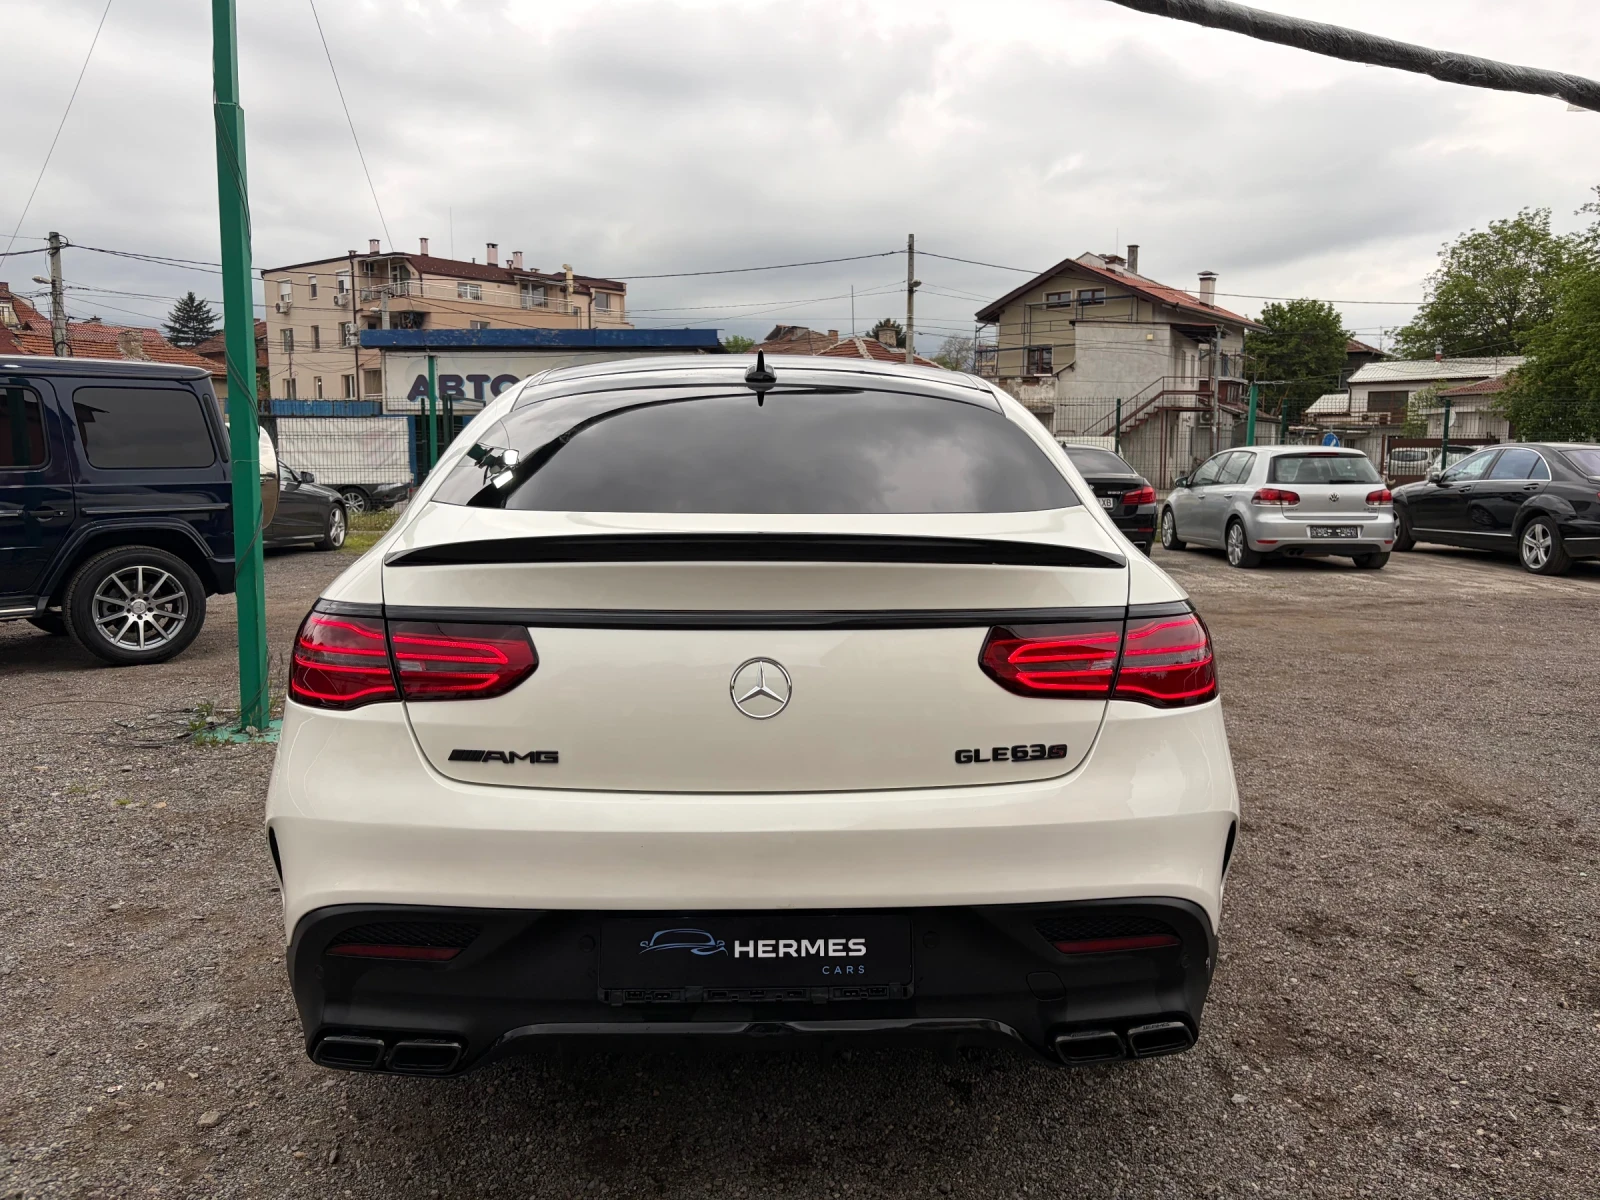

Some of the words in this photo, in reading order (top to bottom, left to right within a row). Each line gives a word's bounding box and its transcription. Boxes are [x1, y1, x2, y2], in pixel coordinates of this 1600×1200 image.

[407, 374, 534, 403] АВТО
[482, 750, 559, 764] AMG
[734, 938, 867, 958] HERMES
[822, 965, 865, 975] CARS
